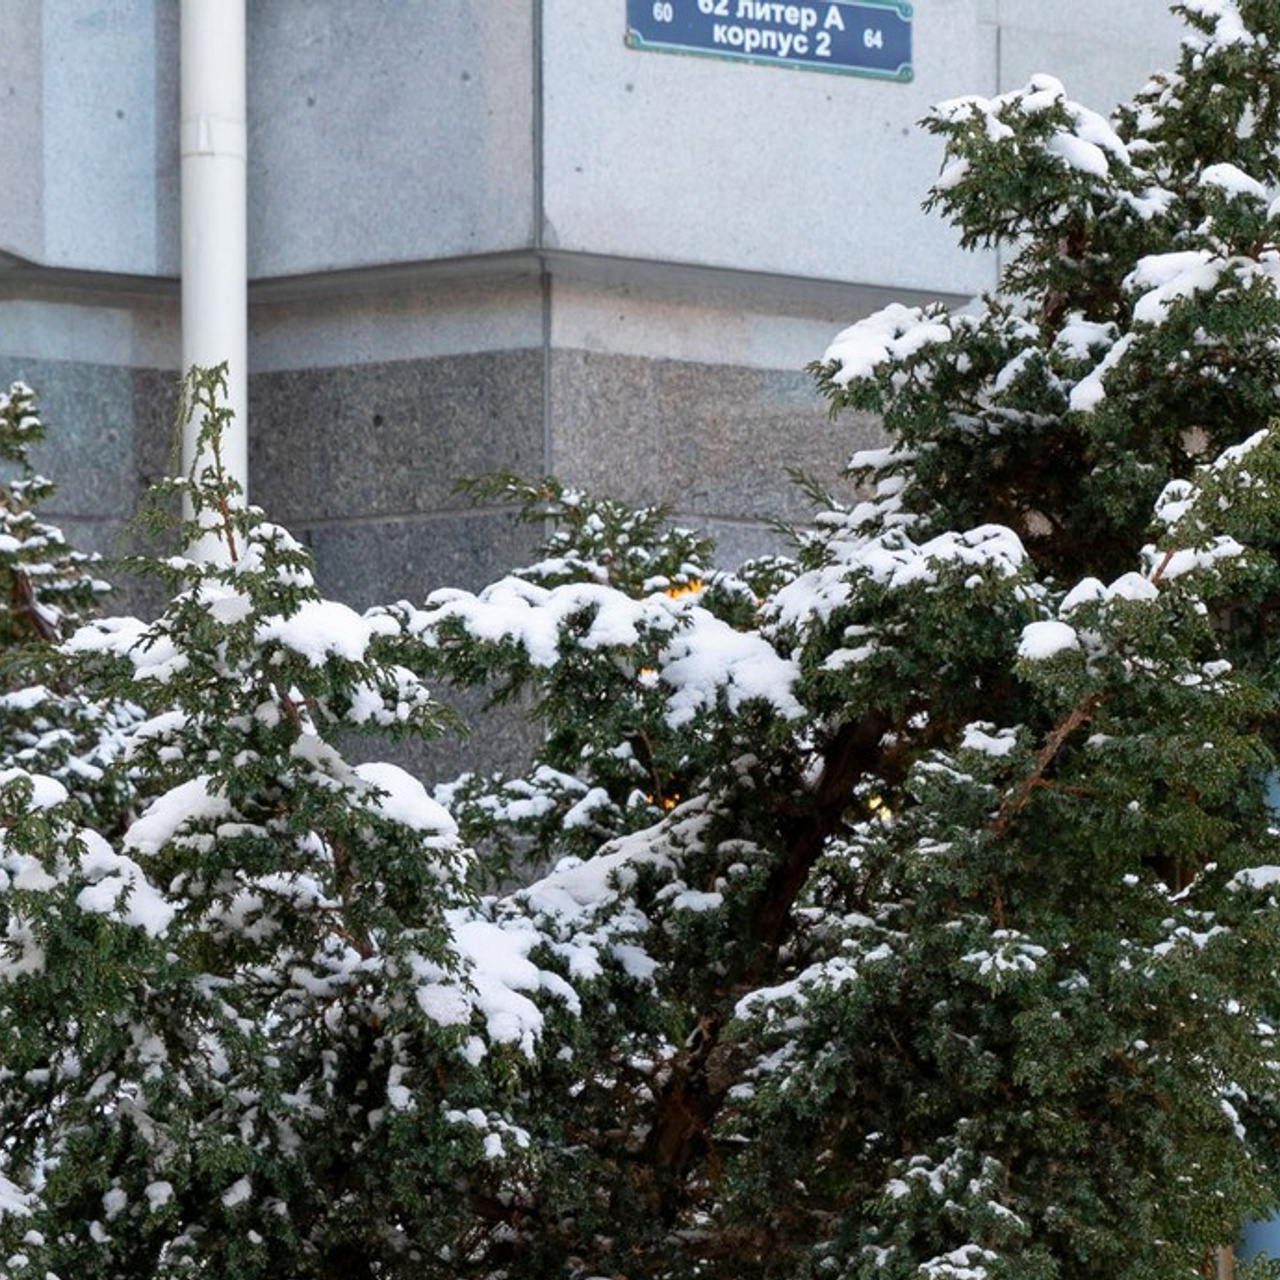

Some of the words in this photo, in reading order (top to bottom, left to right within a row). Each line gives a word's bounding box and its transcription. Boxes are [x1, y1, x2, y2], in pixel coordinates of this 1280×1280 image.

[652, 2, 674, 23] 60
[697, 0, 728, 16] 62
[735, 0, 818, 30] литер
[824, 6, 846, 31] А
[712, 23, 809, 57] корпус
[814, 32, 832, 56] 2
[863, 29, 883, 49] 64
